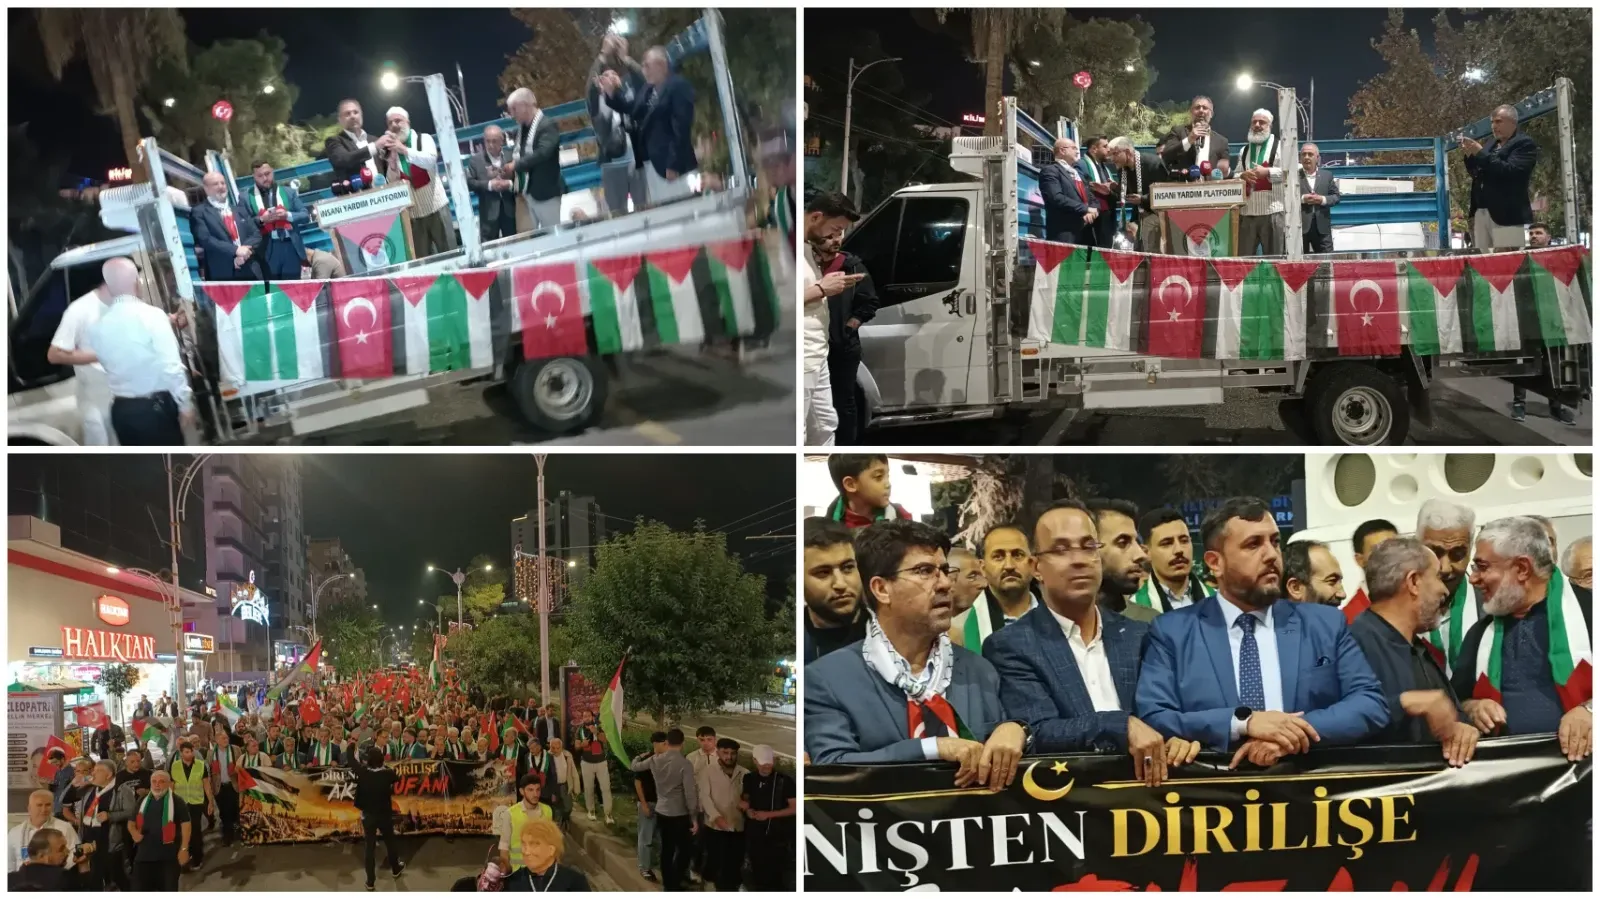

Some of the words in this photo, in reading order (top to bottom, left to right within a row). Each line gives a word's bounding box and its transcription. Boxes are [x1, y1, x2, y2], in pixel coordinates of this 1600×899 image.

[343, 200, 369, 212] YARDIM
[369, 190, 408, 205] PLATFORMU
[1177, 190, 1202, 198] YARDIM
[1203, 188, 1242, 197] PLATFORMU
[62, 627, 155, 662] HALKTAN
[321, 770, 359, 781] DİREN
[393, 776, 450, 796] UFANI
[803, 808, 1088, 887] NİŞTEN
[1109, 786, 1418, 860] DİRİLİŞE
